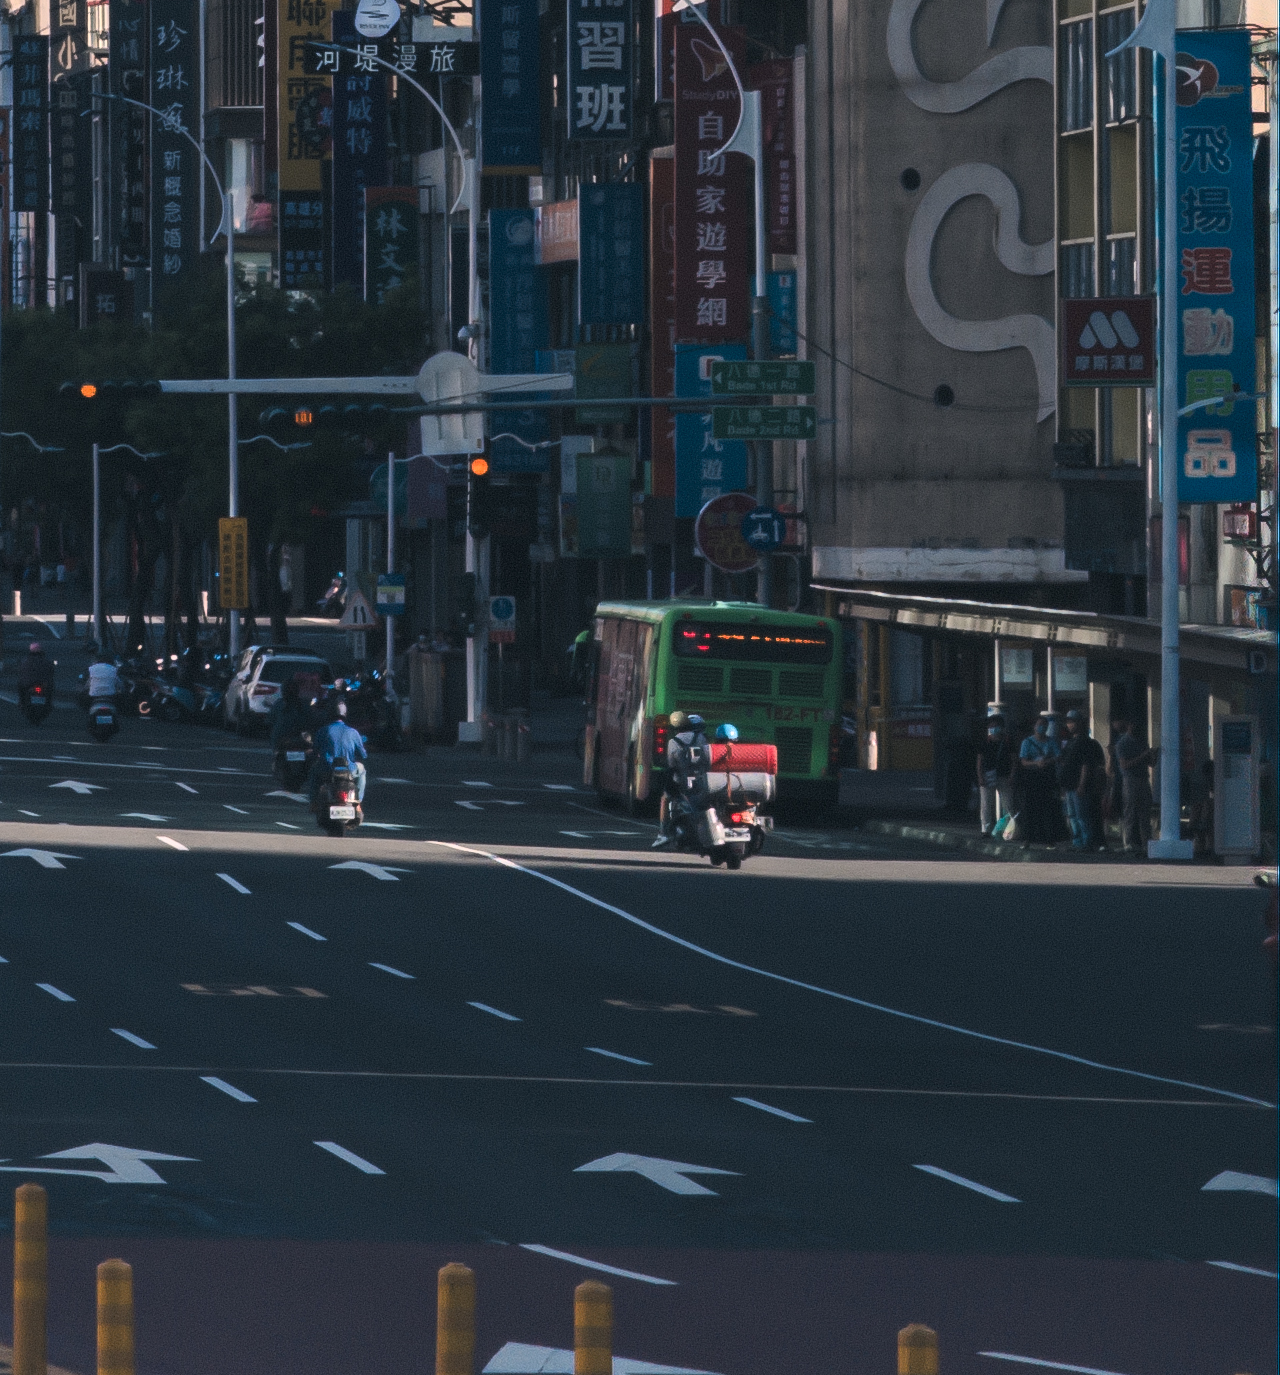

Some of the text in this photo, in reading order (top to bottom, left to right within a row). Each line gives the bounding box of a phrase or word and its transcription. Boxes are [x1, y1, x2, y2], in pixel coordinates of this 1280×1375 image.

[315, 44, 455, 74] 河堤漫旅
[681, 89, 738, 104] StudyDIY
